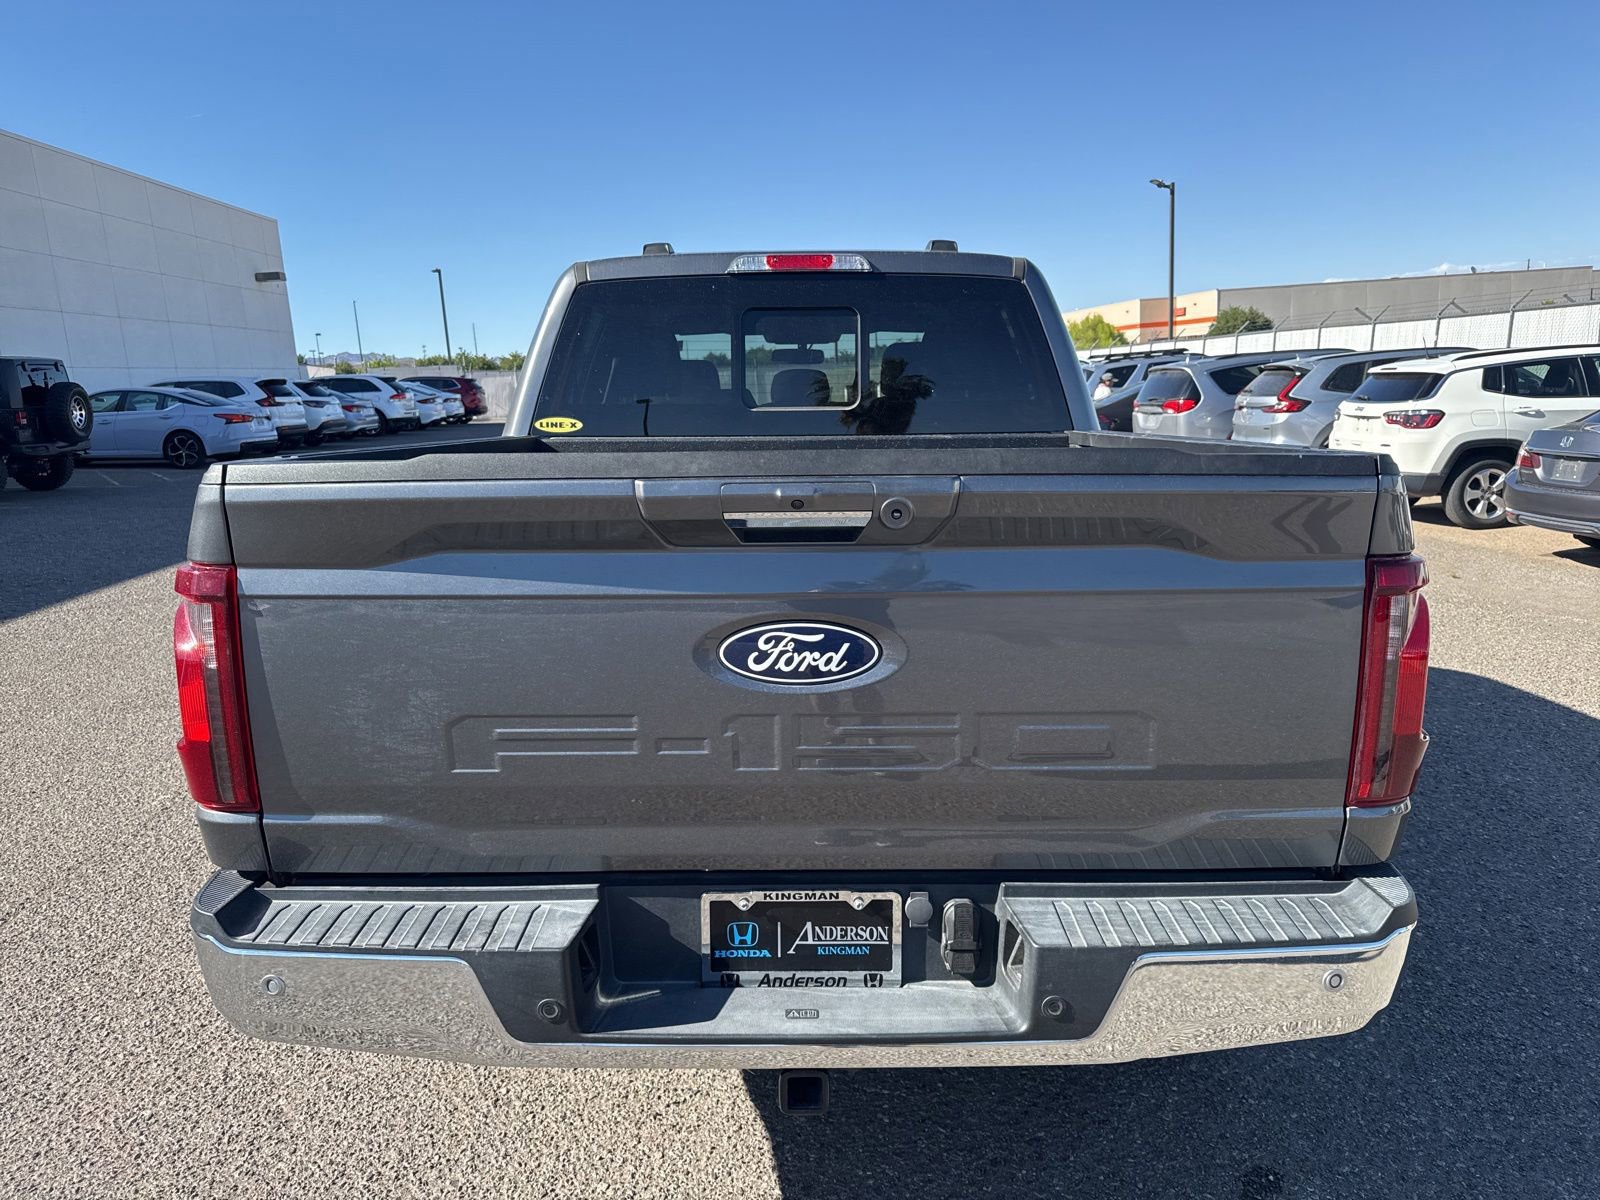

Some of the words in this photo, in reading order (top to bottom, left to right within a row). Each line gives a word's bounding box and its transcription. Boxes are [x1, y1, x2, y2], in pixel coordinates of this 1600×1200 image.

[539, 421, 578, 429] LINE-X
[747, 631, 851, 672] Ford
[444, 710, 1157, 772] F-150
[763, 892, 840, 900] KINGMAN
[714, 949, 772, 958] HONDA
[817, 946, 870, 955] KINGMAN
[757, 973, 848, 988] Anderson
